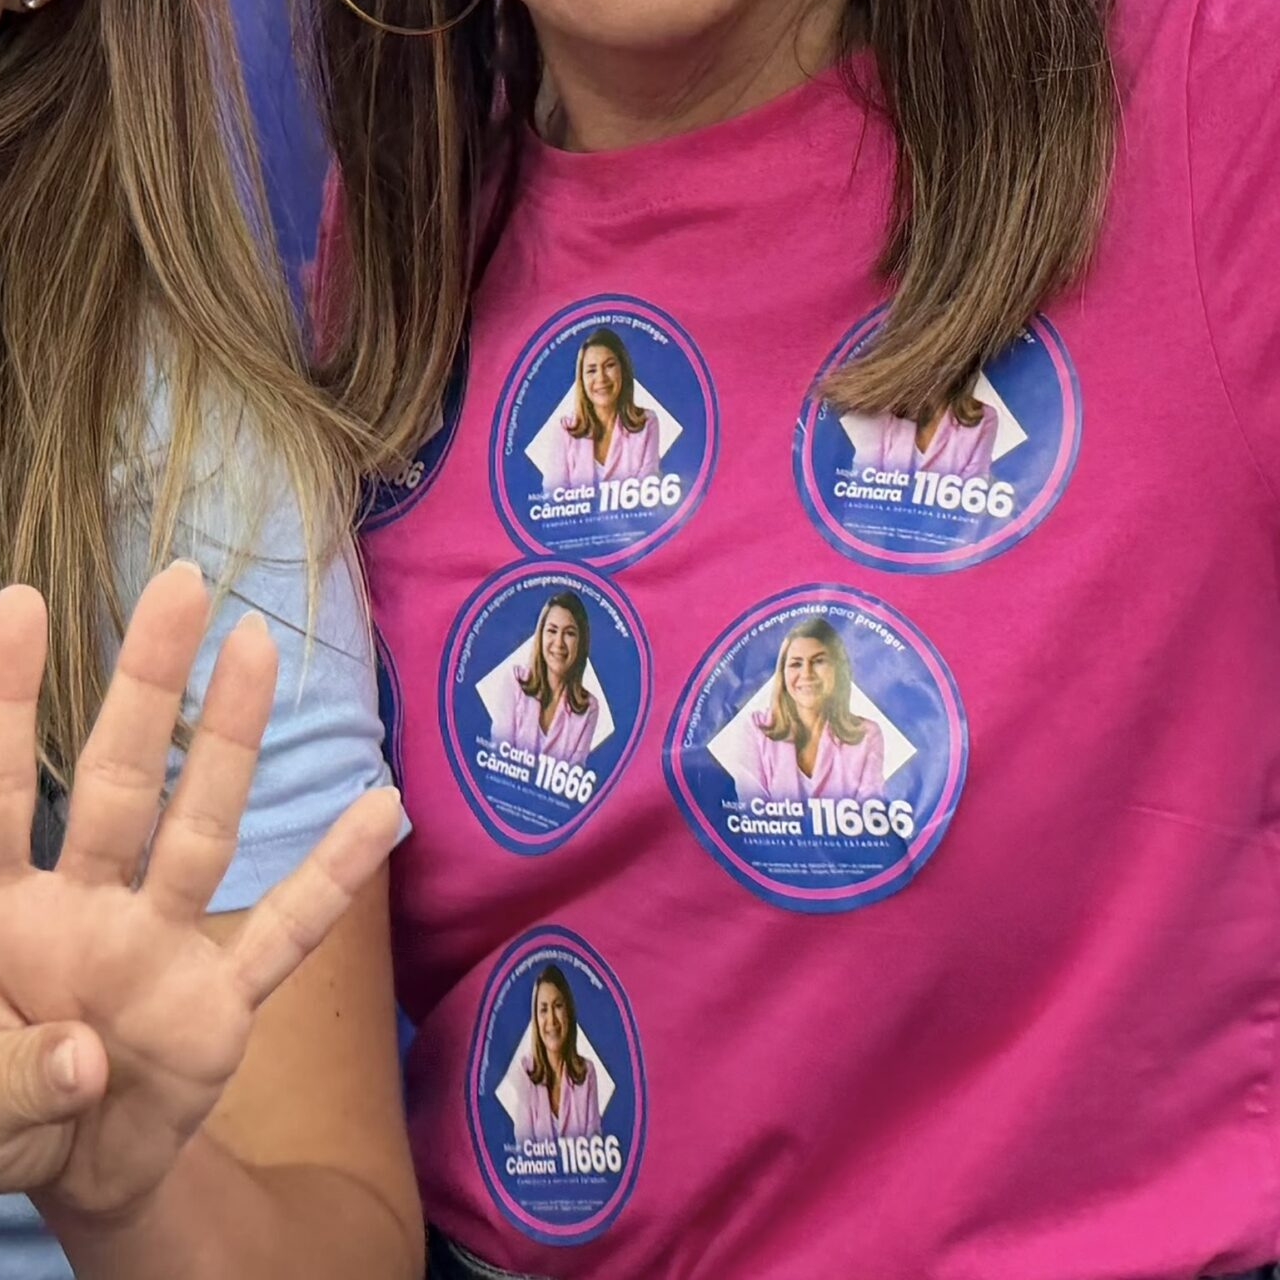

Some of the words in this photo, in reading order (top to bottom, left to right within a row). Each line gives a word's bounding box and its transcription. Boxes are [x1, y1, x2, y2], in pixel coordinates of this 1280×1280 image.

[555, 314, 612, 345] compromisso
[611, 314, 632, 325] para
[631, 318, 669, 345] proteger
[529, 502, 591, 521] Câmara
[598, 473, 682, 512] 11666
[553, 484, 595, 503] Carla
[833, 482, 902, 502] Câmara
[911, 471, 1014, 518] 11666
[862, 467, 910, 486] Carla
[523, 575, 582, 590] compromisso
[599, 596, 630, 638] proteger
[683, 694, 705, 748] Coragem
[703, 664, 722, 695] para
[758, 604, 828, 632] compromisso
[828, 605, 855, 620] para
[854, 614, 907, 652] proteger
[499, 741, 535, 768] Carla
[476, 750, 530, 783] Câmara
[535, 753, 596, 804] 11666
[727, 815, 802, 835] Câmara
[807, 798, 914, 840] 11666
[750, 797, 804, 816] Carla
[506, 1155, 557, 1175] Câmara
[558, 1134, 622, 1174] 11666
[523, 1138, 557, 1157] Carla
